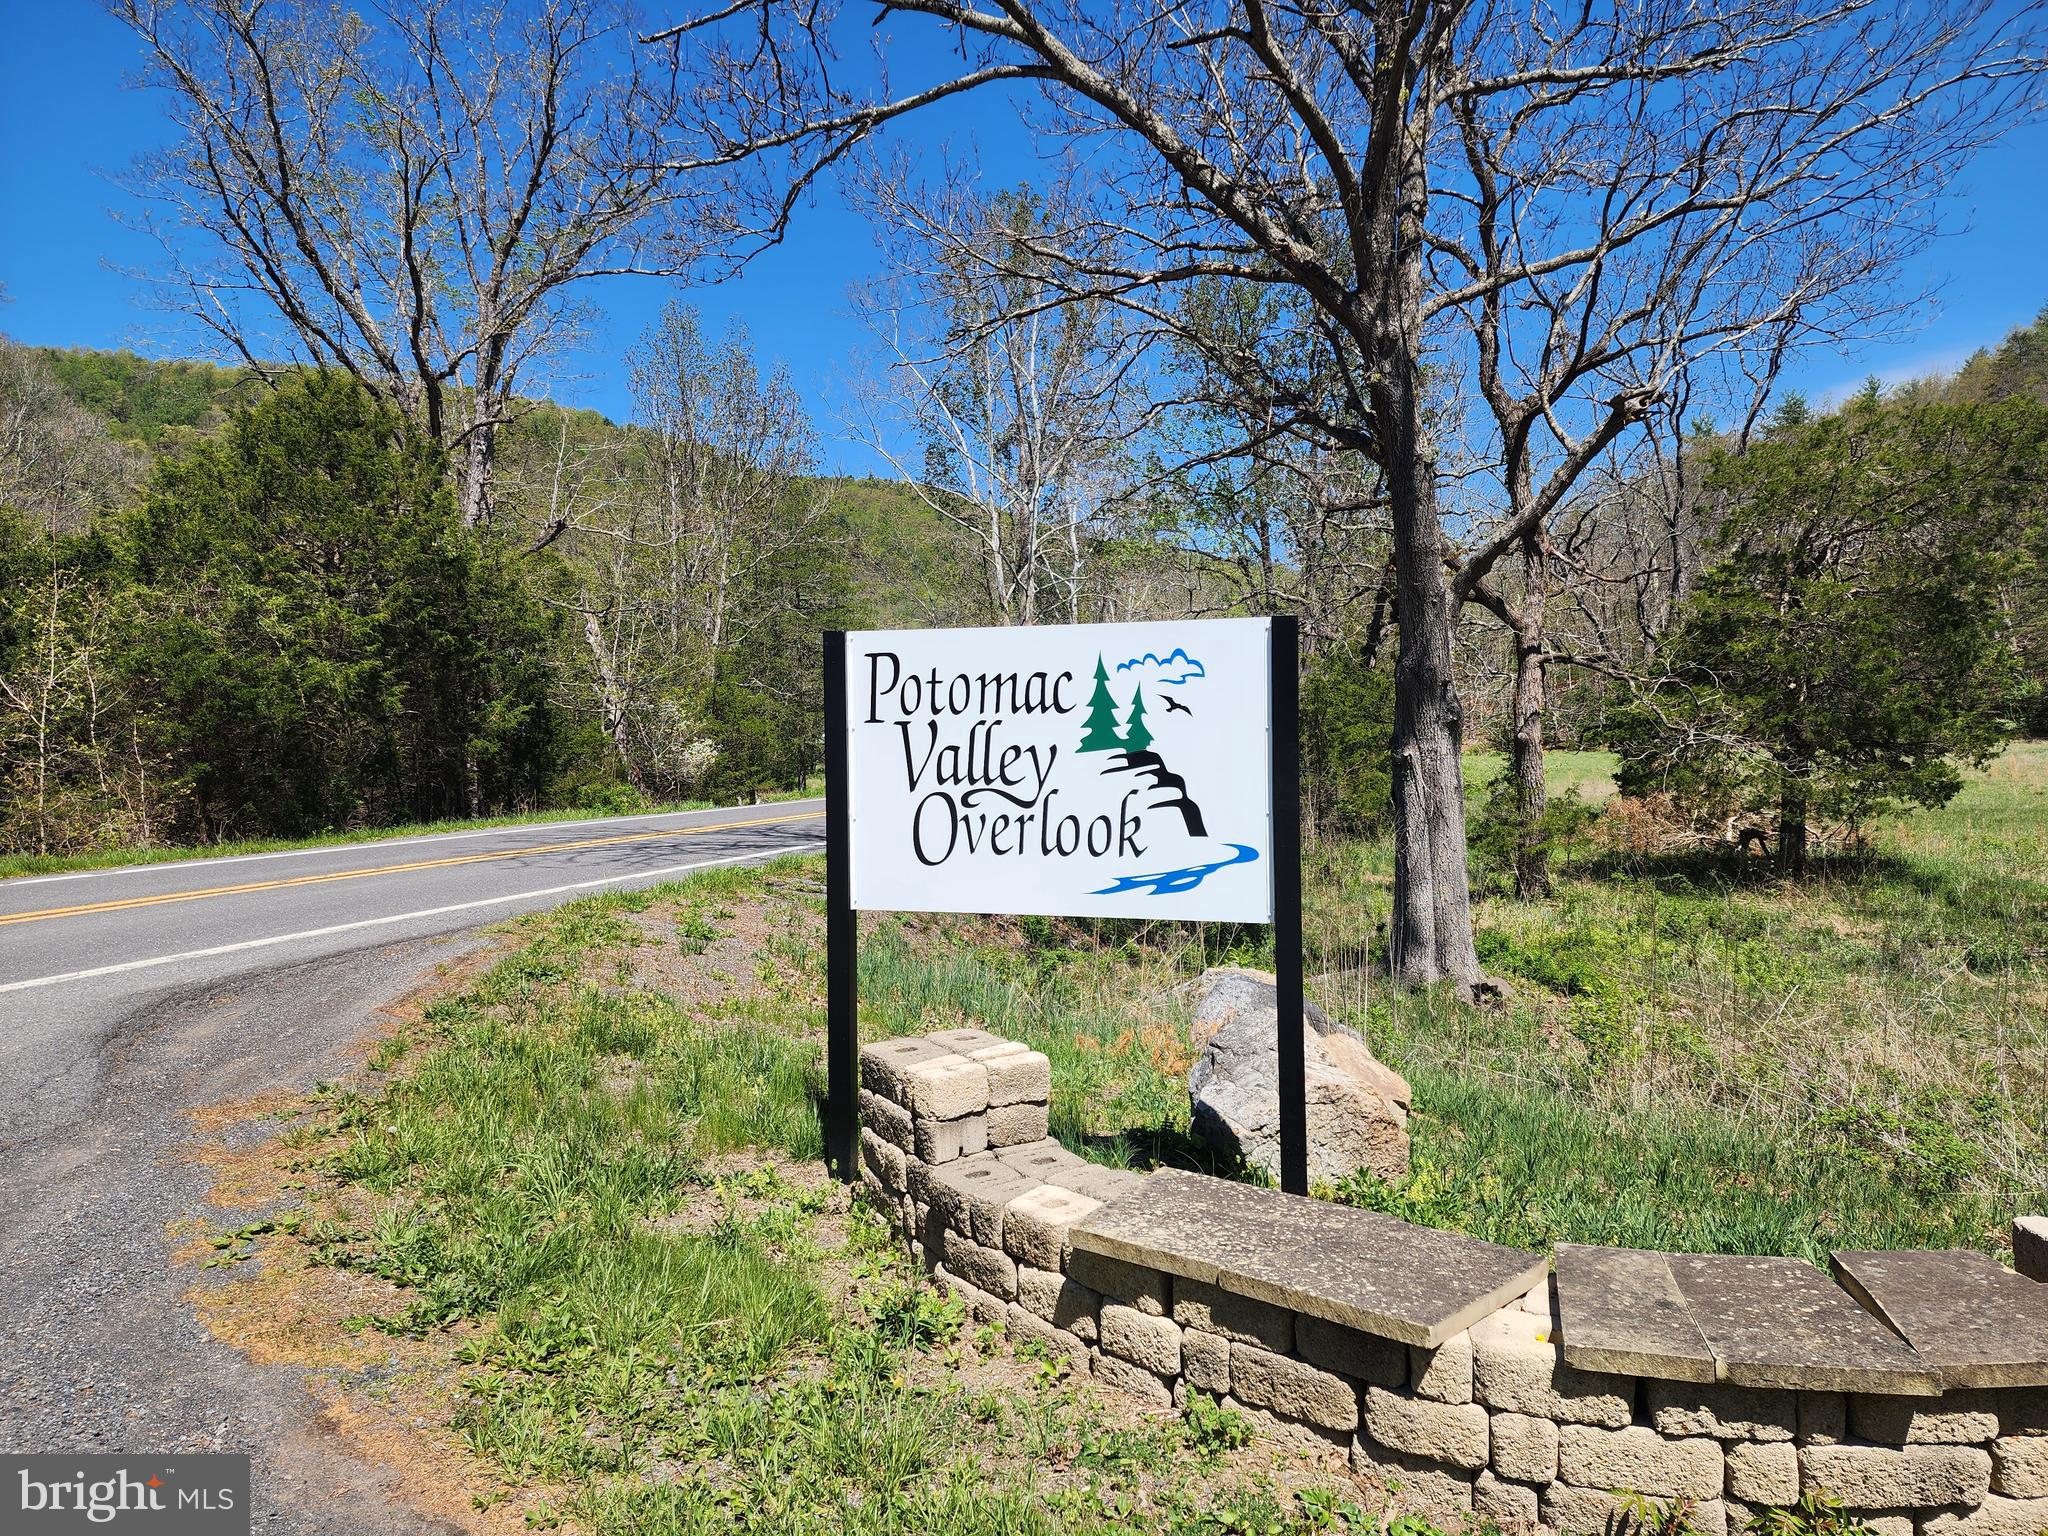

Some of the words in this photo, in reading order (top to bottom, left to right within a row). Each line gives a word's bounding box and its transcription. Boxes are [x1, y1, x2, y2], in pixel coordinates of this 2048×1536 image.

[864, 652, 1077, 724] Potomac
[893, 720, 1058, 808] Valley
[913, 789, 1148, 866] Overlook
